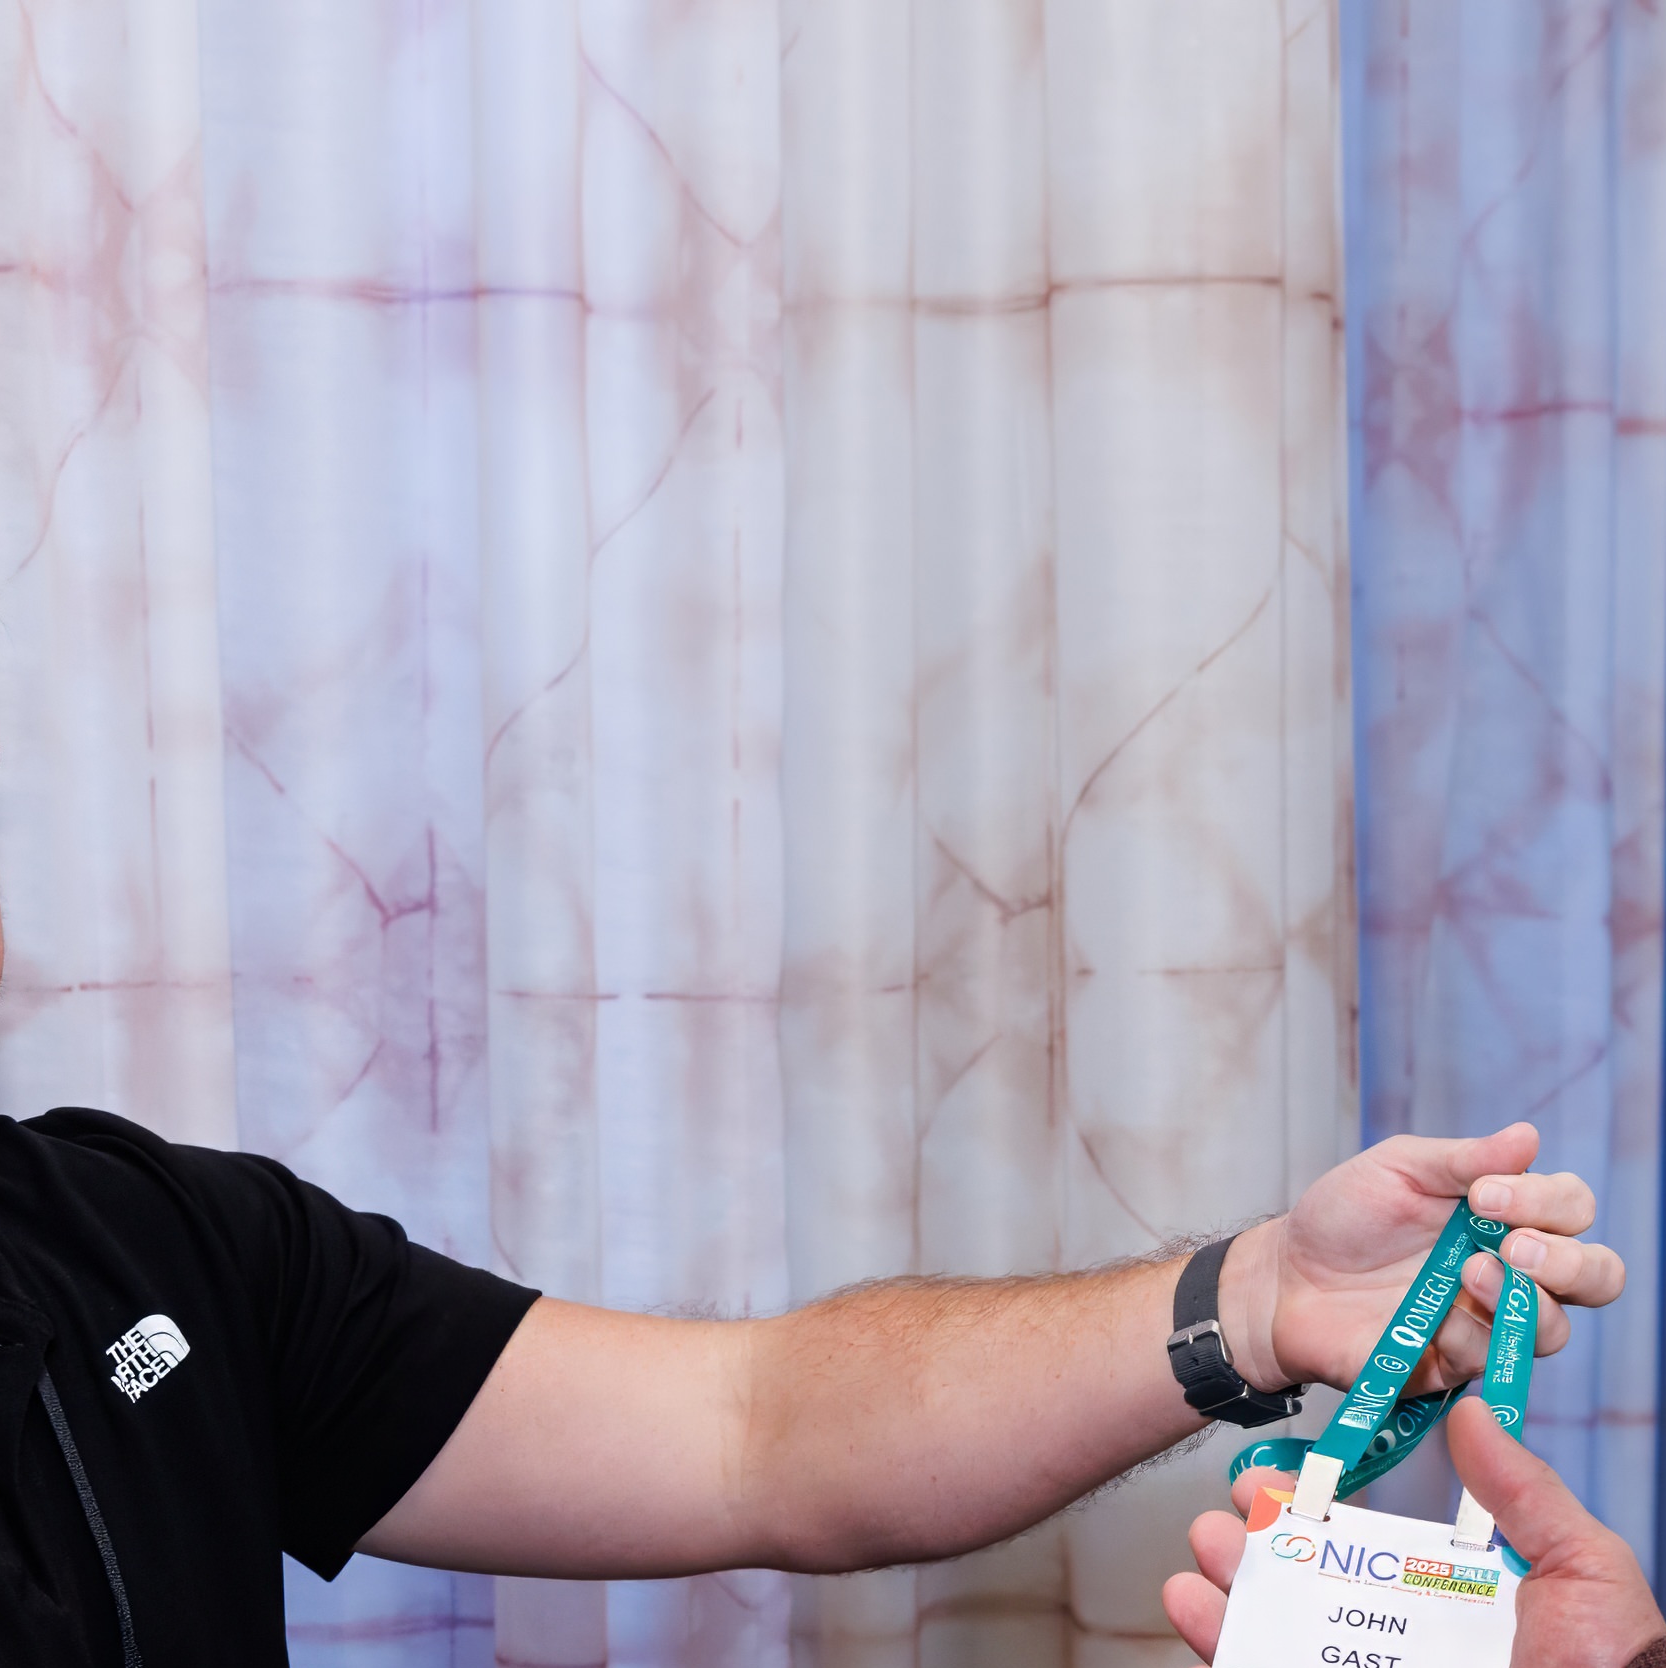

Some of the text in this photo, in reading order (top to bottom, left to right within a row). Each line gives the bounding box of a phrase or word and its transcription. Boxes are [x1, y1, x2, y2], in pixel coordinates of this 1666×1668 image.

[1504, 1266, 1533, 1324] EGA
[106, 1329, 146, 1364] THE
[1350, 1380, 1396, 1415] NIC
[1404, 1272, 1456, 1332] OMEGA
[124, 1356, 171, 1403] FACE
[1320, 1540, 1400, 1581] NIC
[1406, 1558, 1451, 1577] 2025
[1403, 1573, 1496, 1597] CONFERENCE
[1328, 1606, 1407, 1635] JOHN
